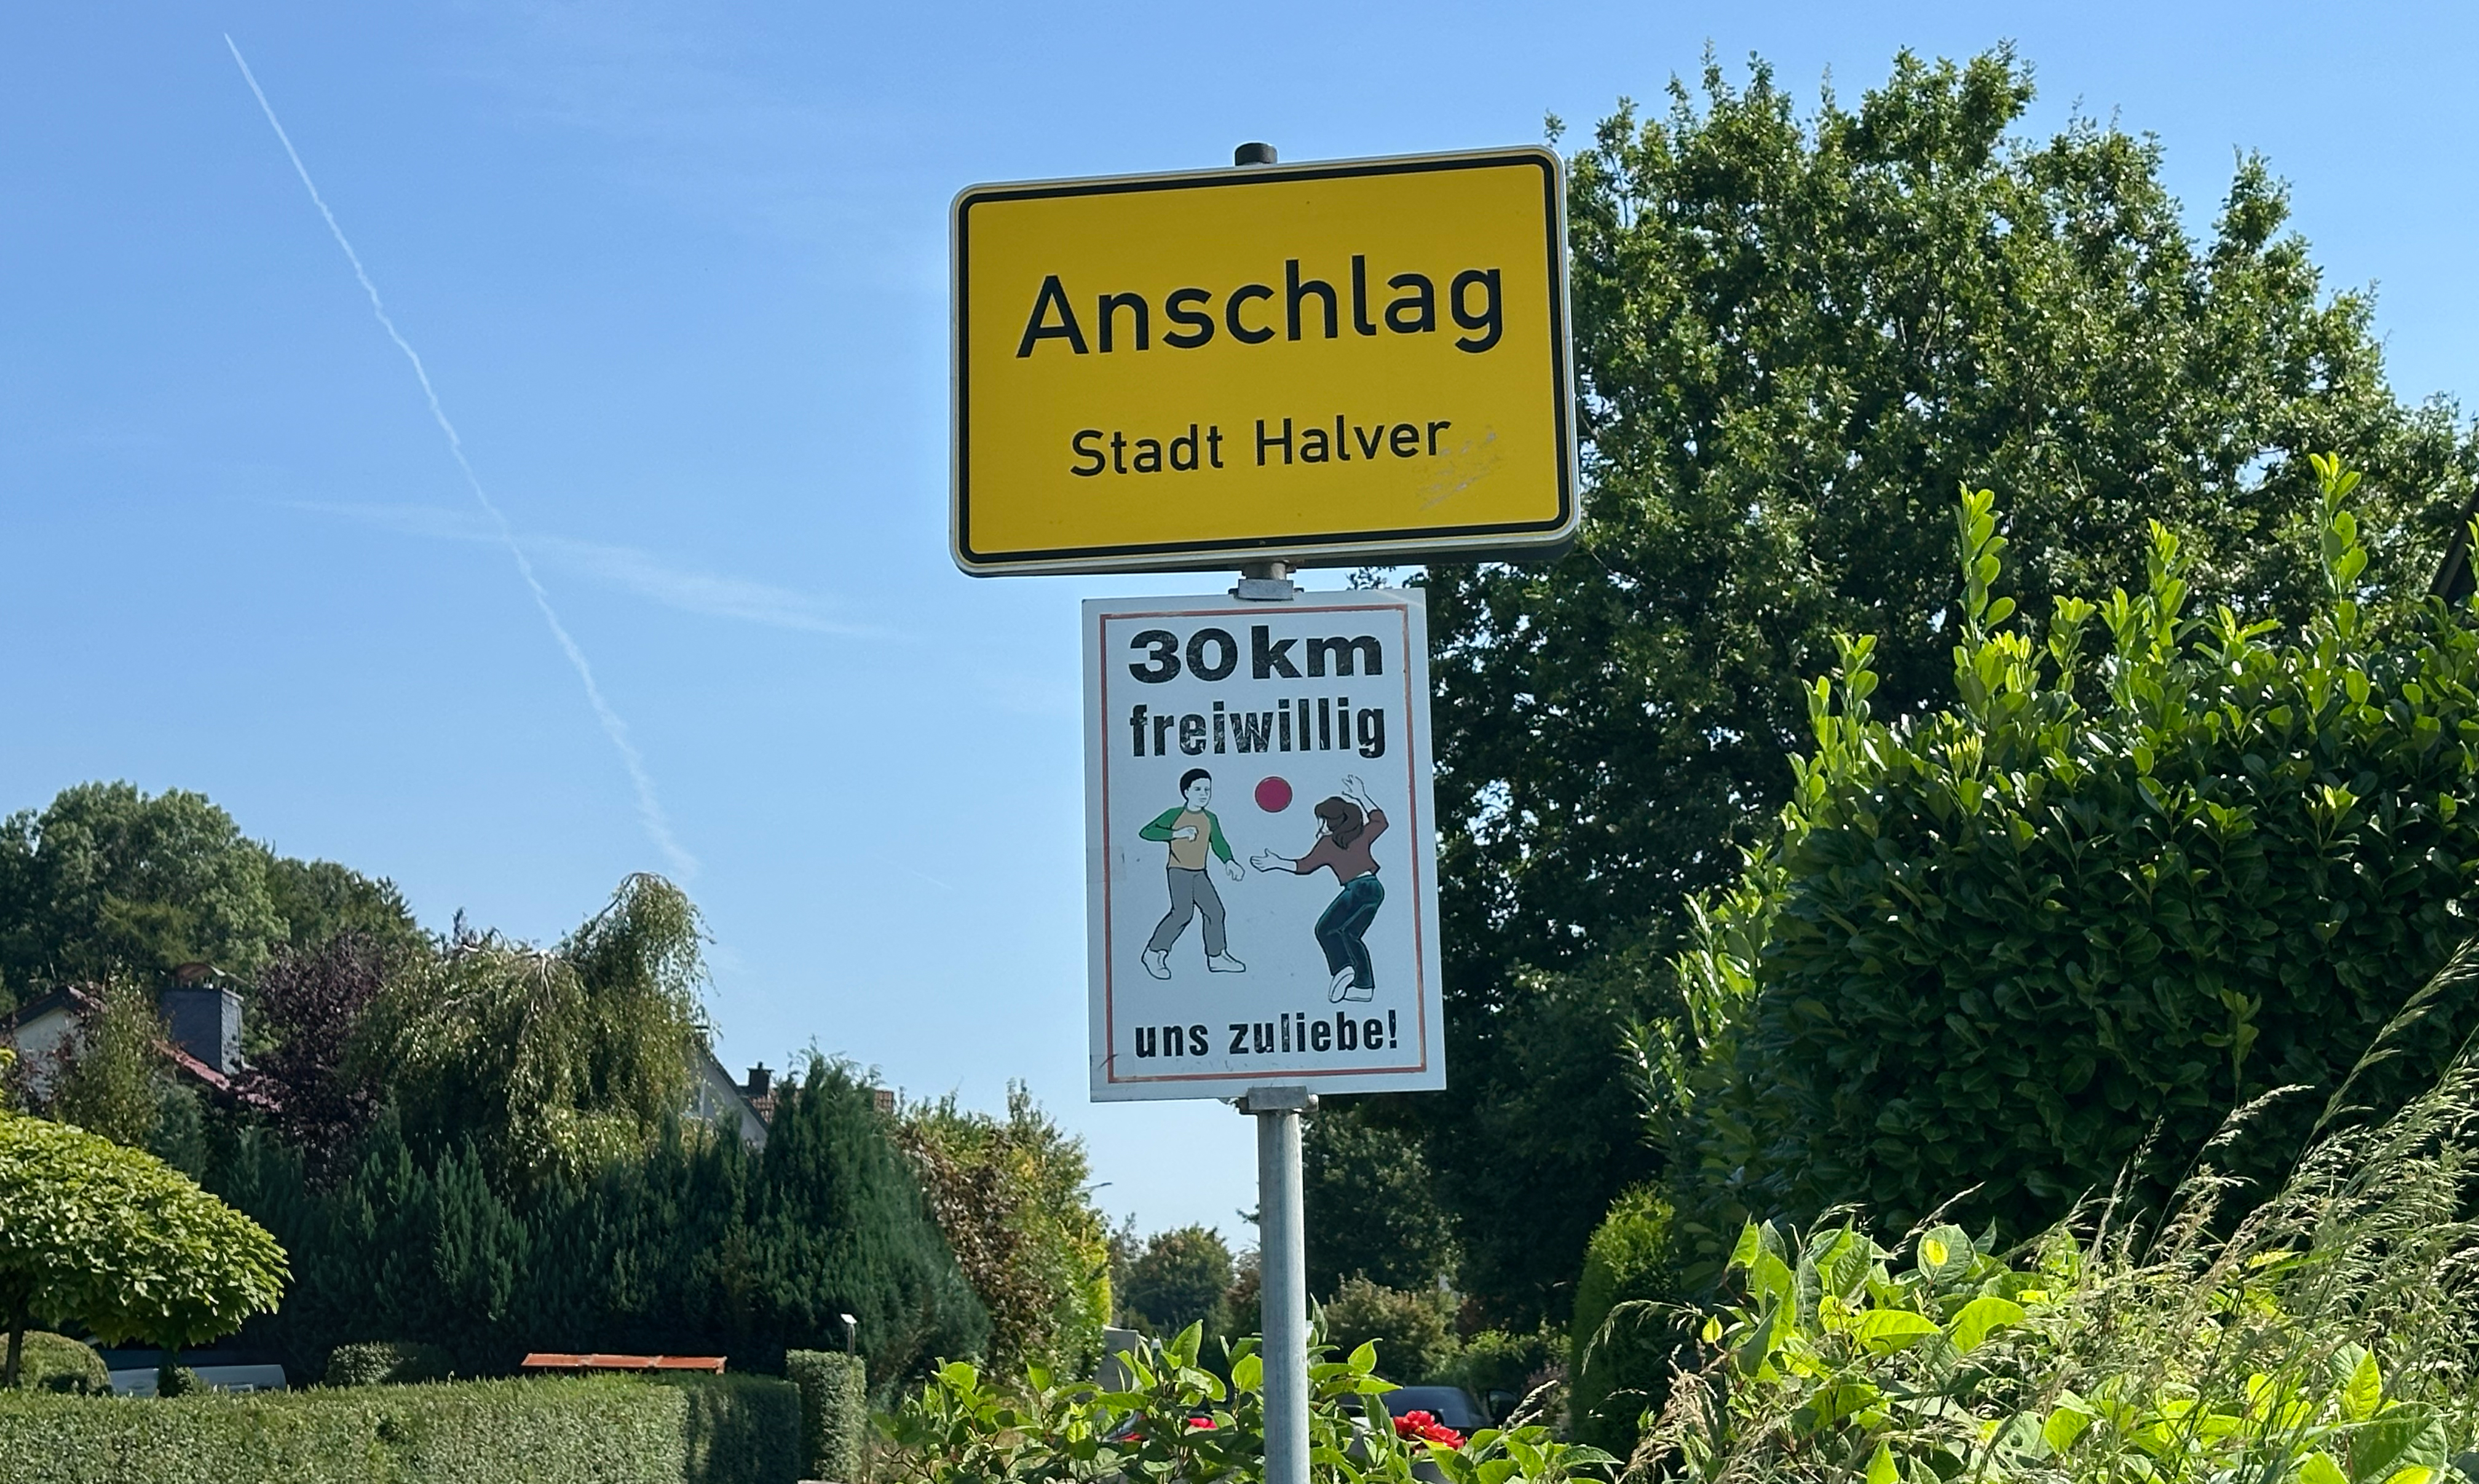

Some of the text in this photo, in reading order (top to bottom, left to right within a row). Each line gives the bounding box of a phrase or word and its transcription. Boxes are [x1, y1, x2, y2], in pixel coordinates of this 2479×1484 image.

[1016, 255, 1503, 358] Anschlag
[1070, 415, 1452, 477] Stadt Halver
[1129, 625, 1383, 684] 30 km
[1130, 697, 1386, 759] freiwillig
[1136, 1010, 1397, 1059] uns zuliebe!
